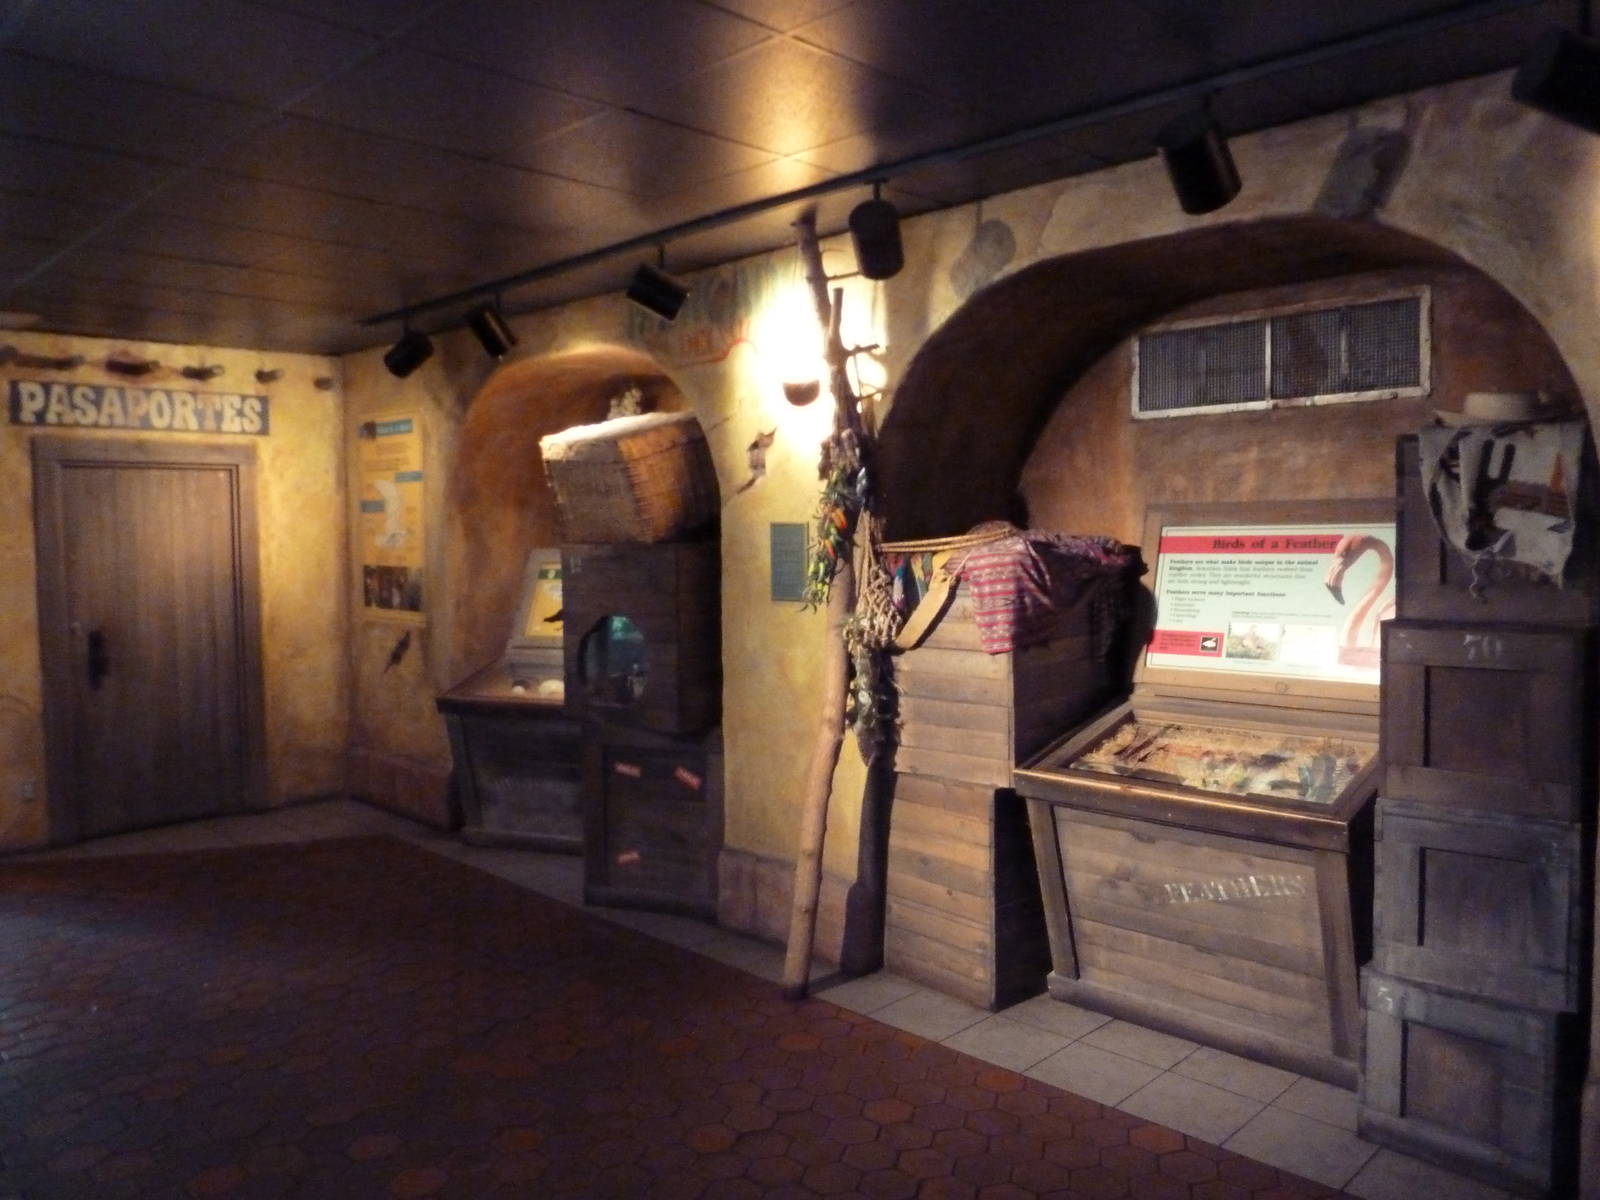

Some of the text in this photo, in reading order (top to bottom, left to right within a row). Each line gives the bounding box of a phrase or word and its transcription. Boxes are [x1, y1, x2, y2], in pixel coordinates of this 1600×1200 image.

[17, 380, 263, 433] PASAPORTES
[1212, 536, 1337, 550] Birds of a Feather
